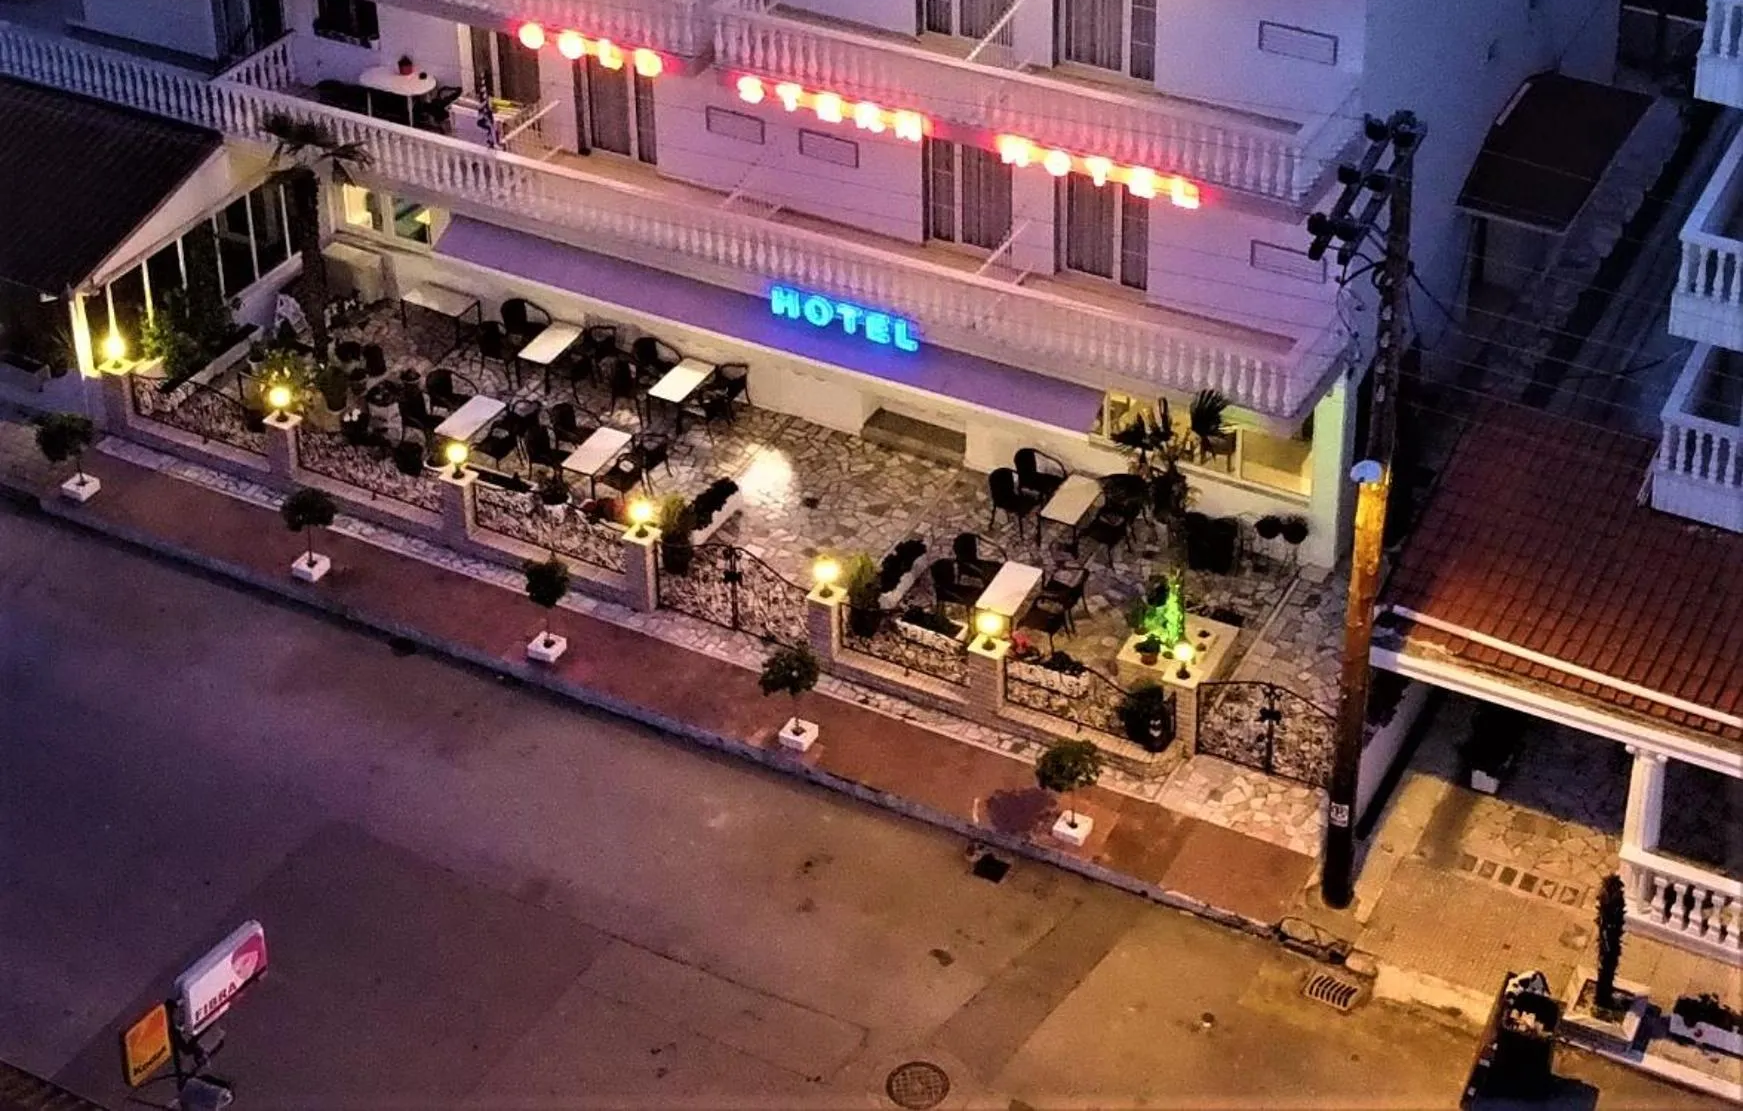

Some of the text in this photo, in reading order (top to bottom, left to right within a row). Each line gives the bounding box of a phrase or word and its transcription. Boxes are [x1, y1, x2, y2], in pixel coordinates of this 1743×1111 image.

[998, 134, 1200, 209] HOTEL
[771, 286, 919, 352] HOTEL
[194, 980, 238, 1021] FIBRA
